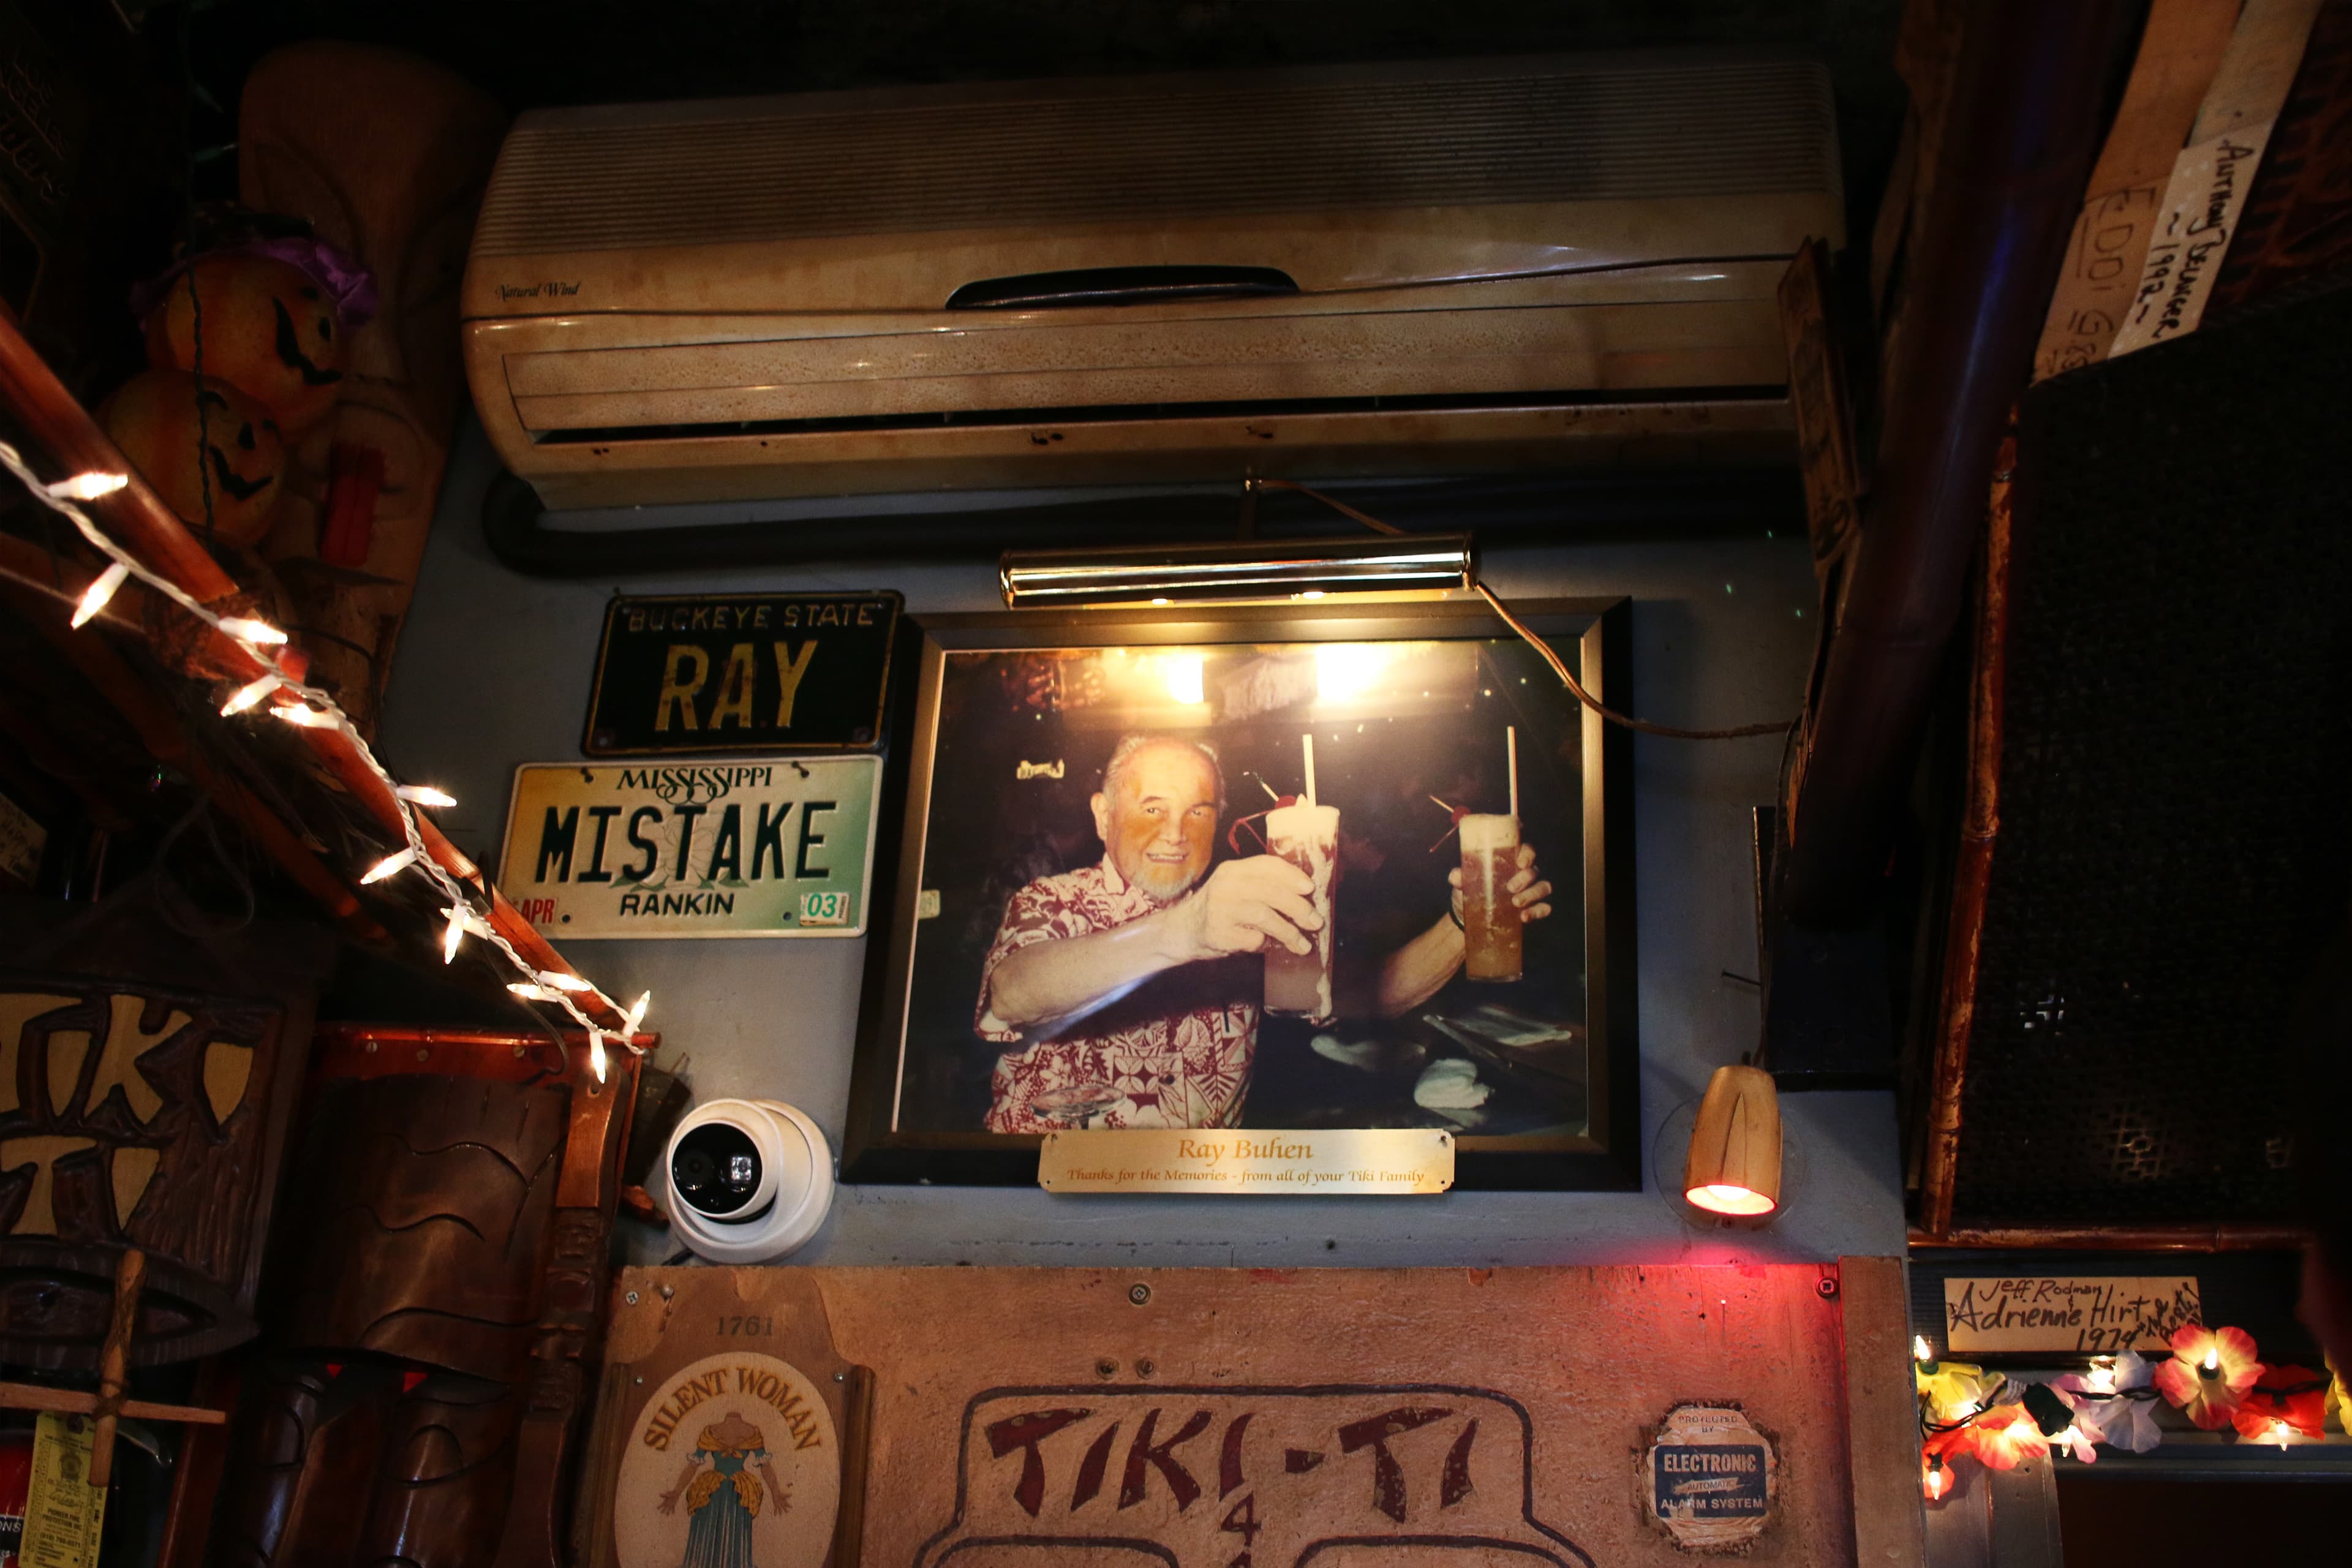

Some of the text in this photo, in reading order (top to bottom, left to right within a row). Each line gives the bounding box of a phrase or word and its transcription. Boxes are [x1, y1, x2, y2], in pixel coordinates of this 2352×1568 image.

[495, 281, 581, 301] Natural Wind
[628, 603, 878, 632] BUCKEYE STATE
[654, 639, 819, 731] RAY
[617, 767, 771, 805] MISSISSIPPI
[536, 802, 836, 882] MISTAKE
[522, 899, 555, 924] APR
[620, 894, 734, 916] RANKIN
[808, 893, 837, 918] 03
[1178, 1137, 1313, 1166] Ray Buhen
[1068, 1169, 1114, 1180] Thanks
[1116, 1169, 1137, 1185] for
[1140, 1169, 1161, 1180] the
[1165, 1170, 1227, 1181] Memories
[1241, 1170, 1272, 1183] from
[1276, 1169, 1293, 1181] all
[1297, 1170, 1310, 1184] of
[1313, 1172, 1345, 1186] your
[1348, 1169, 1374, 1182] Tiki
[1379, 1169, 1425, 1186] Family
[1980, 1280, 2101, 1302] Jeff Rodman
[1950, 1281, 2150, 1332] Adrienne Hirt
[717, 1316, 774, 1336] 1761
[644, 1367, 821, 1452] SILENT WOMAN
[1678, 1415, 1738, 1423] PROTECTED
[1664, 1453, 1757, 1473] ELECTRONIC
[1687, 1479, 1735, 1491] AUTOMATIC
[1660, 1498, 1763, 1510] ALARM SYSTEM
